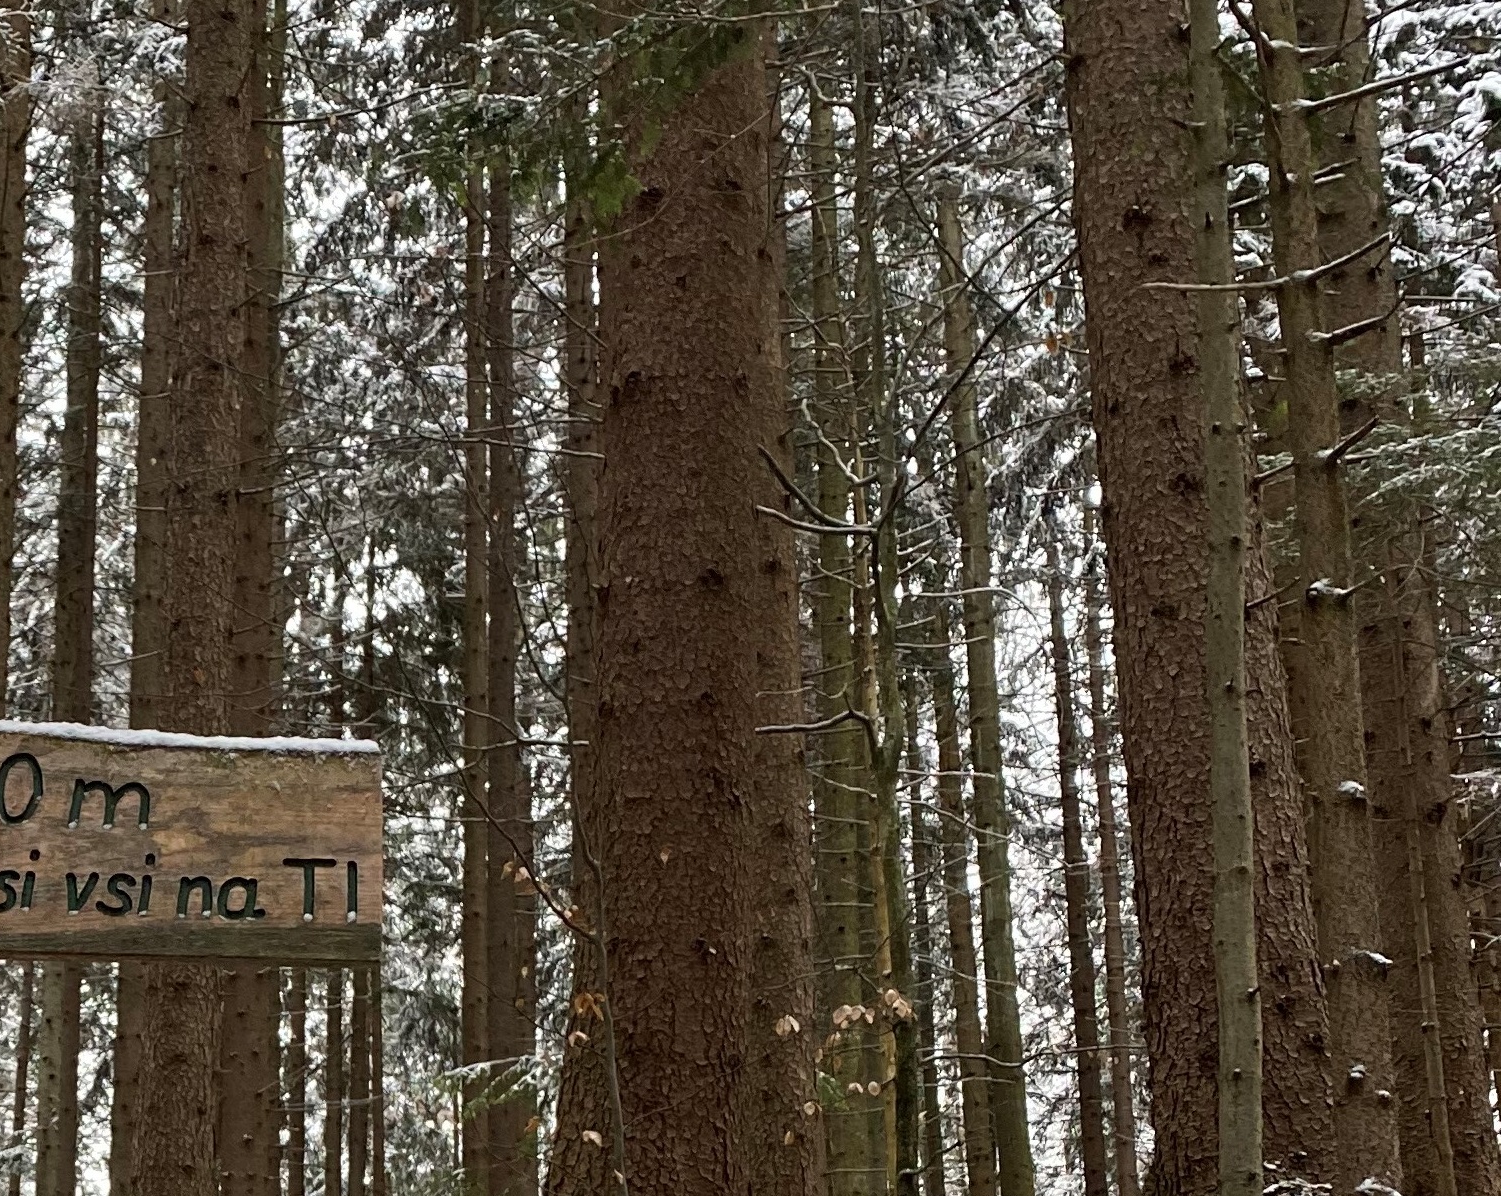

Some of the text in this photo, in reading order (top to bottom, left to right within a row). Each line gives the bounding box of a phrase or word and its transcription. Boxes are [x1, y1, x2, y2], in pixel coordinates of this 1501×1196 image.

[68, 778, 153, 830] m
[66, 852, 157, 918] vsi
[176, 874, 266, 922] na
